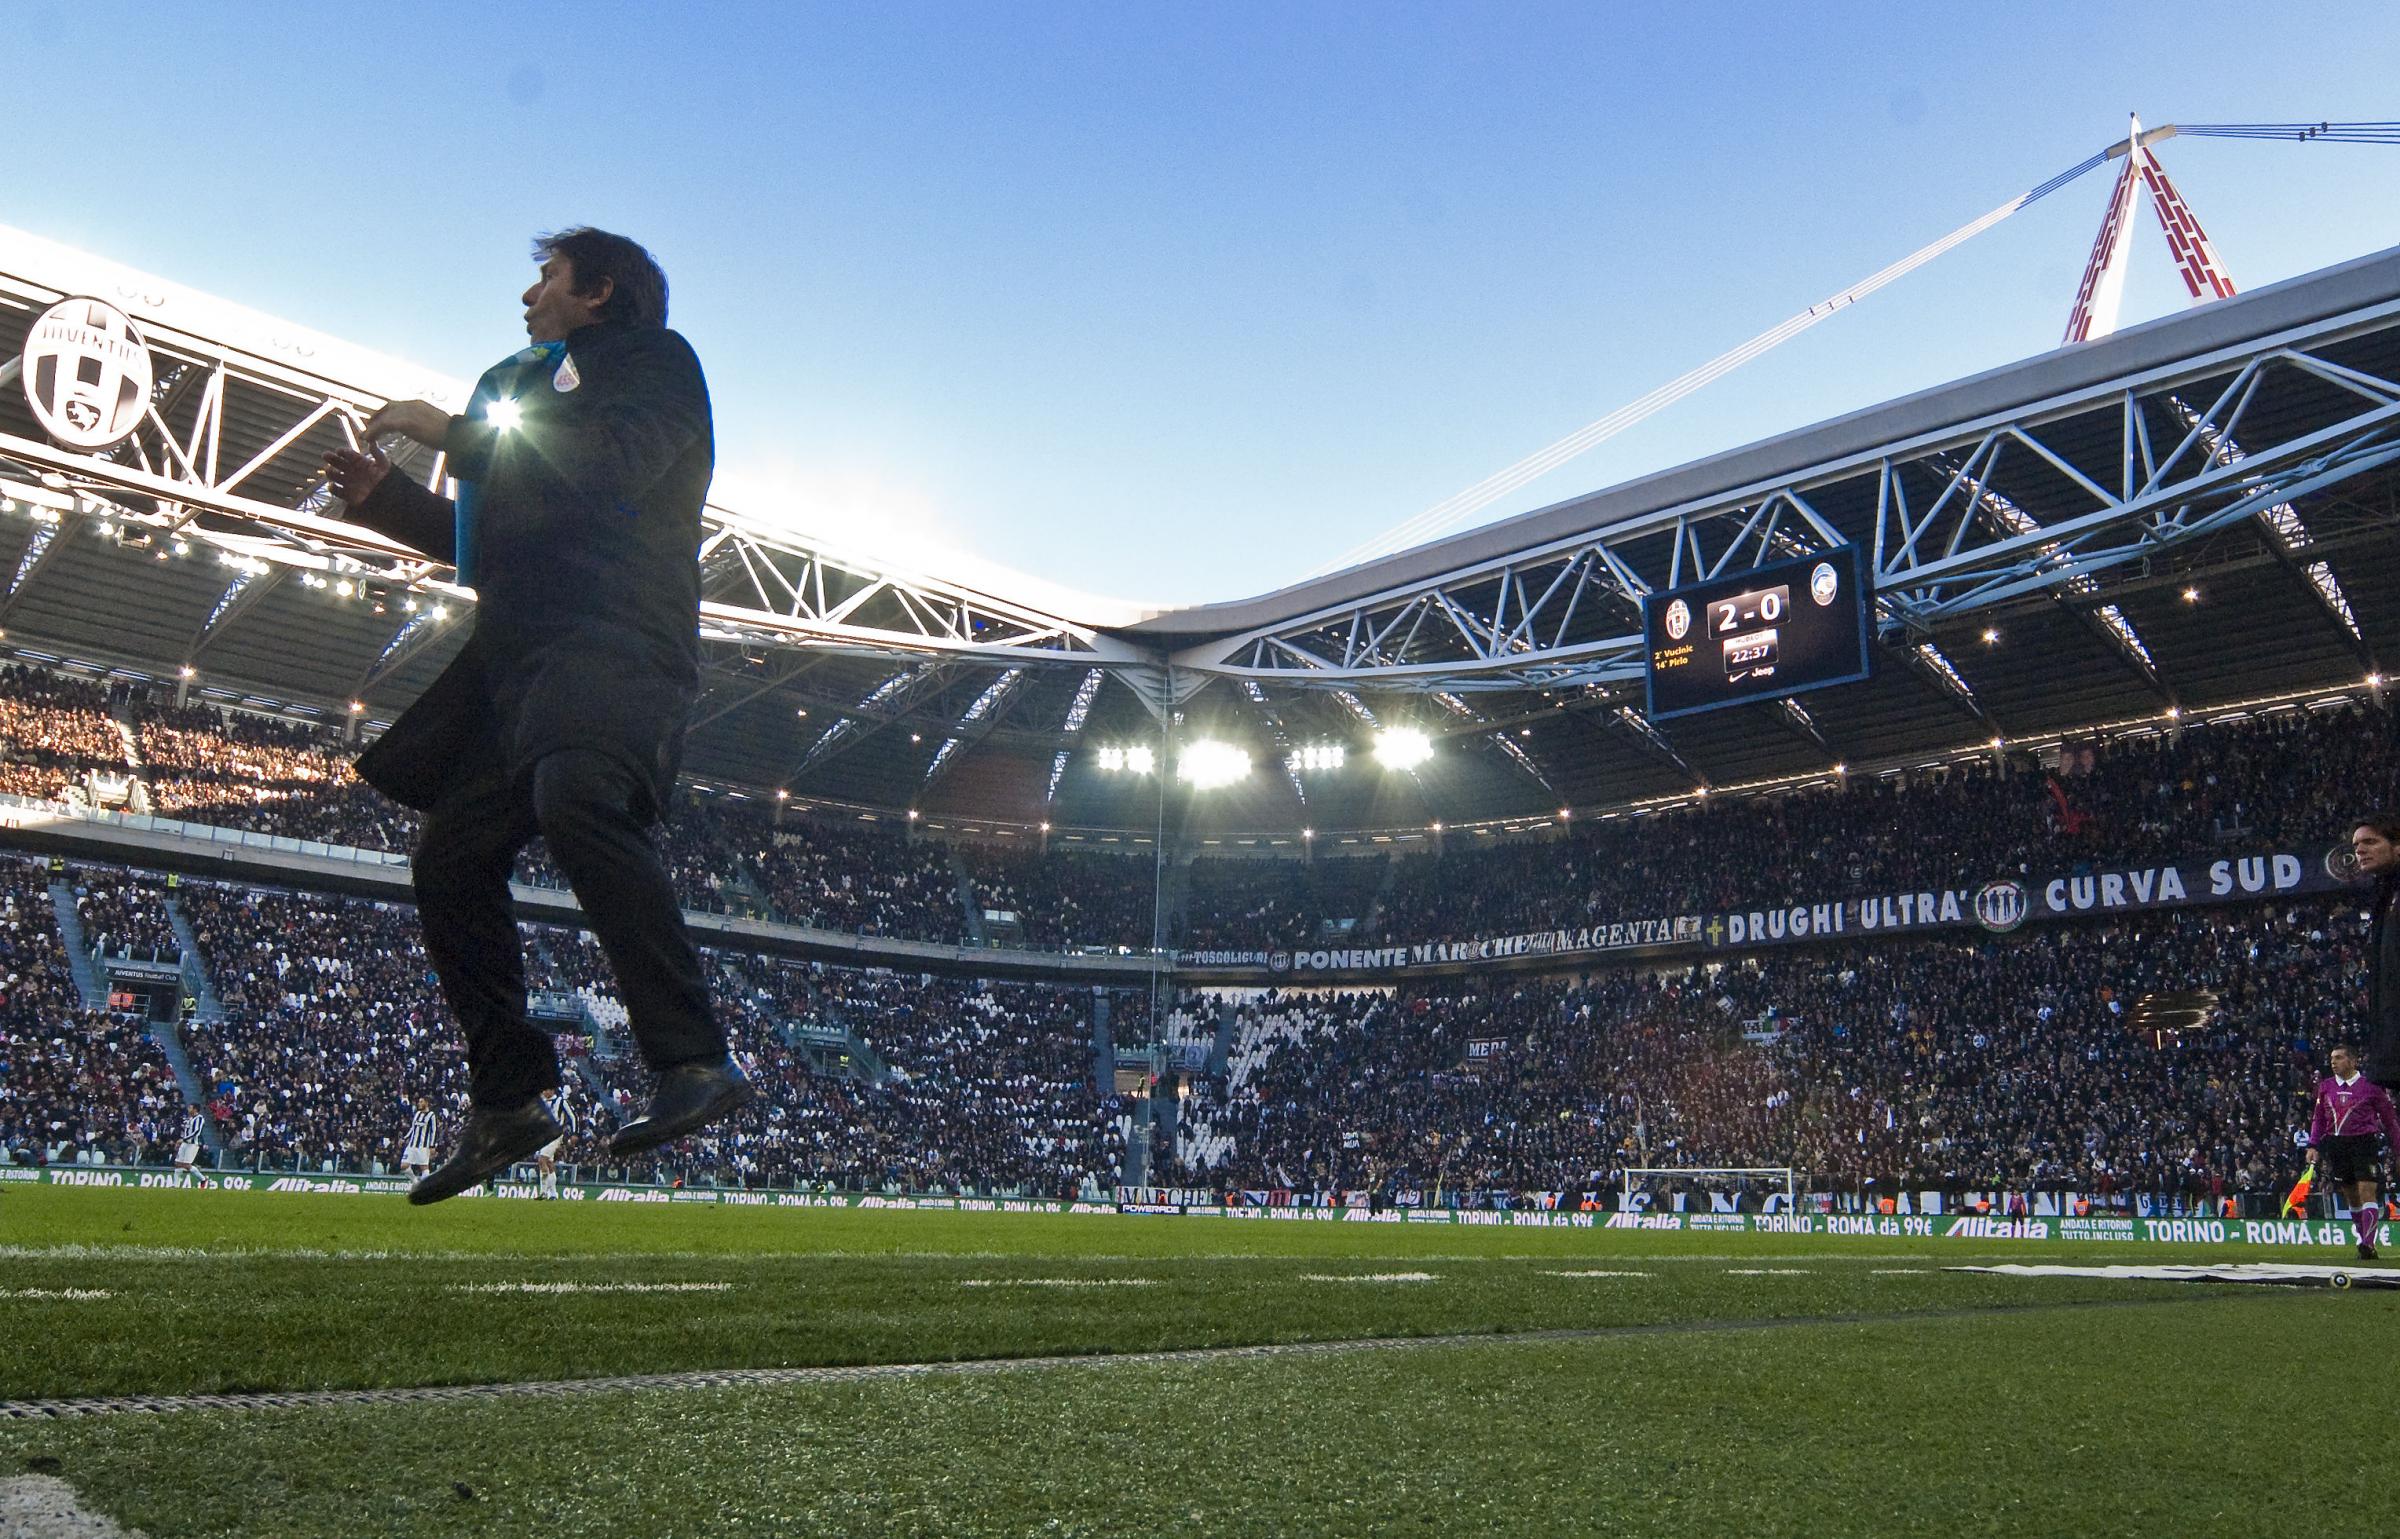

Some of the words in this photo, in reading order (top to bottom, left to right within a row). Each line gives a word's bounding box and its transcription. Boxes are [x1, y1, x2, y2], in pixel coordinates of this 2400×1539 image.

[1718, 603, 1738, 632] 2
[1760, 593, 1781, 621] 0
[1663, 645, 1694, 658] Vucinic
[1731, 645, 1769, 664] 22:37
[1669, 656, 1689, 667] Pirlo
[1751, 666, 1775, 678] Jeep
[2045, 867, 2187, 912] CURVA
[2210, 854, 2302, 896] SUD
[1728, 902, 1844, 943] DRUGHI
[1556, 918, 1672, 952] MAGENTA
[1295, 948, 1407, 969] PONENTE
[6, 1169, 40, 1180] RITORNO
[51, 1171, 122, 1186] TORINO
[140, 1174, 192, 1189] ROMA
[267, 1178, 360, 1193] Alitalia
[597, 1189, 669, 1203] Alitalia
[724, 1192, 767, 1205] TORINO
[779, 1194, 811, 1206] ROMA
[857, 1197, 916, 1209] Alitalia
[960, 1200, 995, 1211] TORINO
[1069, 1203, 1117, 1214] Alitalia
[1123, 1205, 1180, 1214] POWERADE
[1271, 1209, 1299, 1220] ROMA
[1456, 1211, 1502, 1225] TORINO
[1514, 1212, 1550, 1226] ROMA
[1554, 1214, 1569, 1227] da
[1572, 1213, 1593, 1227] 99€
[1604, 1213, 1682, 1230] Alitalia
[1752, 1215, 1812, 1233] TORINO
[1827, 1216, 1876, 1235] ROMA
[1880, 1218, 1900, 1236] da
[1903, 1217, 1933, 1237] 99€
[2060, 1219, 2089, 1230] ANDATA
[2098, 1220, 2133, 1231] RITORNO
[2060, 1231, 2089, 1240] TUTTO
[2092, 1231, 2134, 1241] INCLUSO
[2144, 1220, 2224, 1243] TORINO
[2246, 1222, 2313, 1245] ROMA
[2319, 1223, 2345, 1246] da
[2351, 1223, 2391, 1247] 9€
